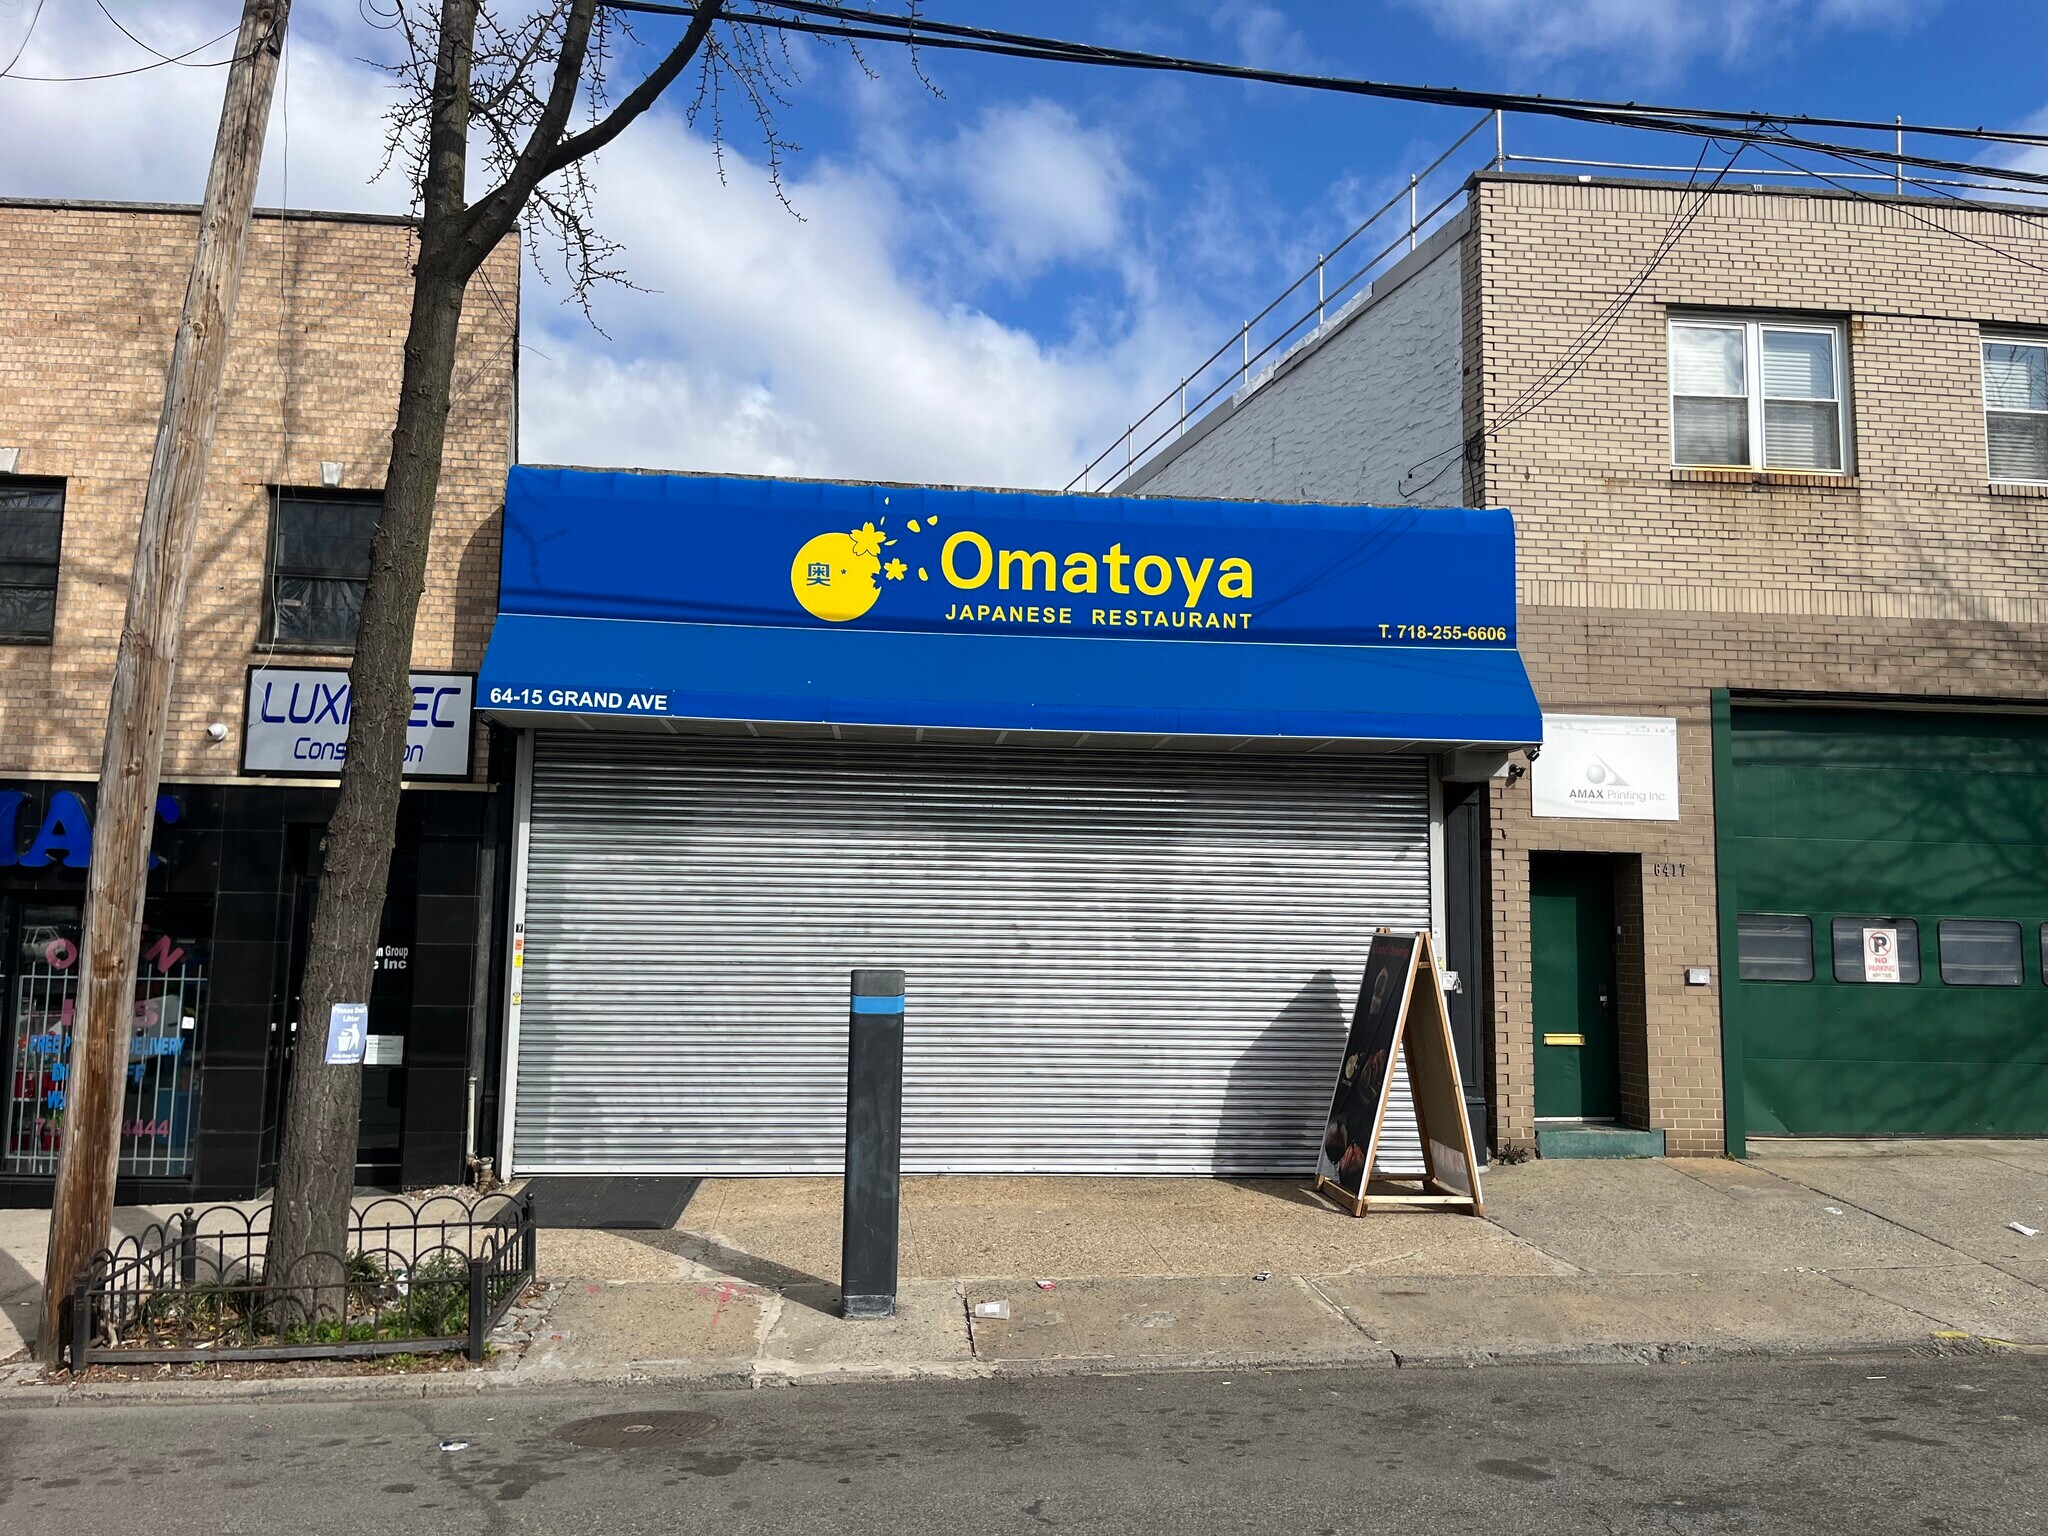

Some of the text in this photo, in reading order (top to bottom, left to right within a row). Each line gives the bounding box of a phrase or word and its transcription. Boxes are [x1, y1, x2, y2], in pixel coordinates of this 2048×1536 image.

[805, 561, 832, 588] 奥
[940, 530, 1254, 608] Omatoya
[945, 603, 1253, 630] JAPANESE RESTAURANT
[1378, 624, 1507, 641] T. 718-255-6606
[261, 682, 462, 728] LUXEC
[490, 687, 668, 711] 64-15 GRAND AVE
[293, 737, 424, 762] Conson
[1569, 788, 1669, 802] AMAX Printing Inc.
[1653, 862, 1686, 878] 6417
[385, 944, 409, 960] Group
[383, 958, 407, 970] Inc
[1868, 964, 1896, 972] PARKING
[30, 1034, 61, 1053] FREE
[130, 1037, 186, 1056] DELIVERY
